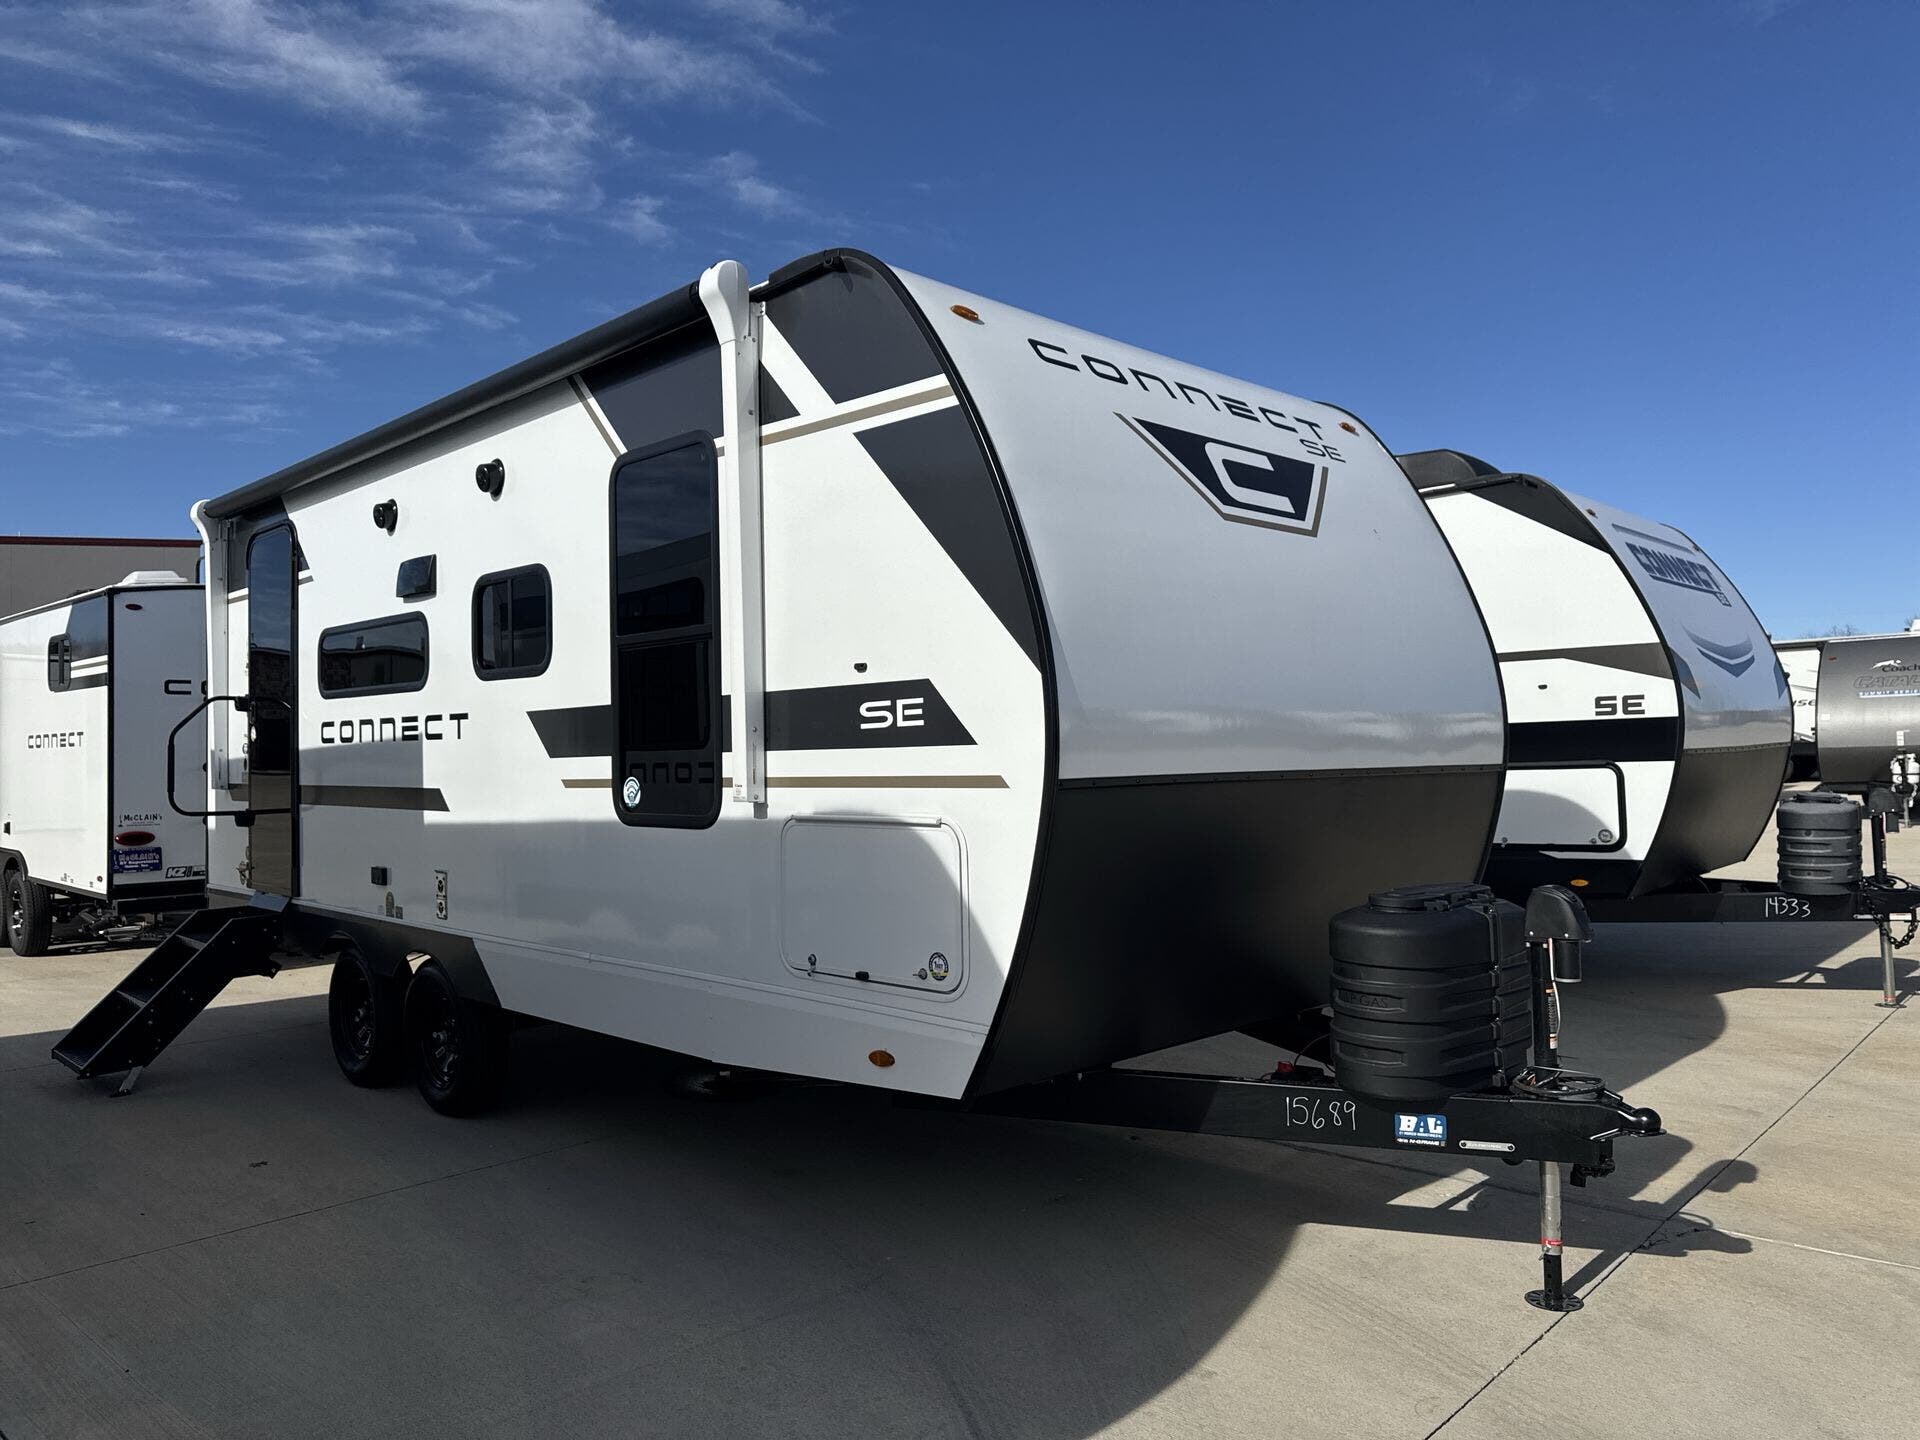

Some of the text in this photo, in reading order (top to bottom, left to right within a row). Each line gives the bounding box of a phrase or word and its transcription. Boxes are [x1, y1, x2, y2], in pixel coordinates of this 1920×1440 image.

[1028, 337, 1323, 440] CONNECT
[1299, 438, 1347, 463] SE
[1625, 542, 1722, 592] CONNECT
[859, 697, 925, 730] SE
[1595, 694, 1646, 716] SE
[27, 731, 84, 749] CONNECT
[320, 712, 469, 744] CONNECT
[1765, 896, 1811, 918] 14333
[1286, 1096, 1356, 1131] 15689
